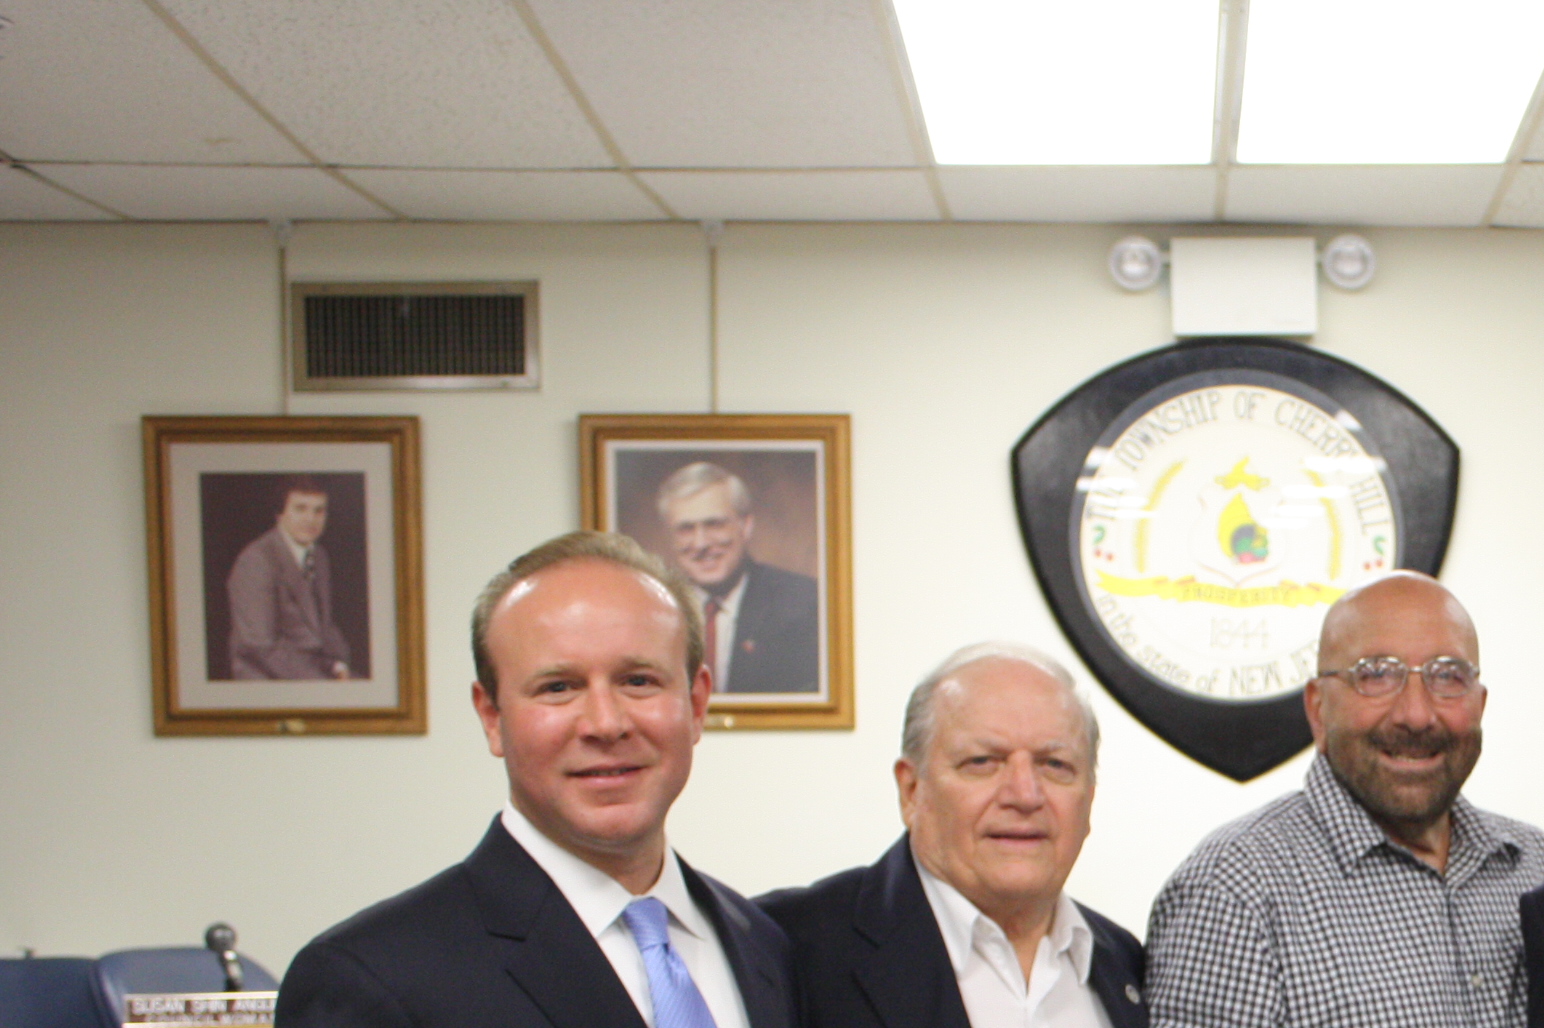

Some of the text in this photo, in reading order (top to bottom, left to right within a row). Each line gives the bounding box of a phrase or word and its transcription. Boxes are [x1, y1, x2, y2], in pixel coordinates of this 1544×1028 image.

[1114, 390, 1220, 471] TOWNSHIP
[1233, 391, 1267, 421] OF
[1350, 475, 1389, 536] HILL
[1210, 617, 1270, 649] 1844
[1195, 669, 1221, 693] of
[1229, 661, 1285, 697] NEW
